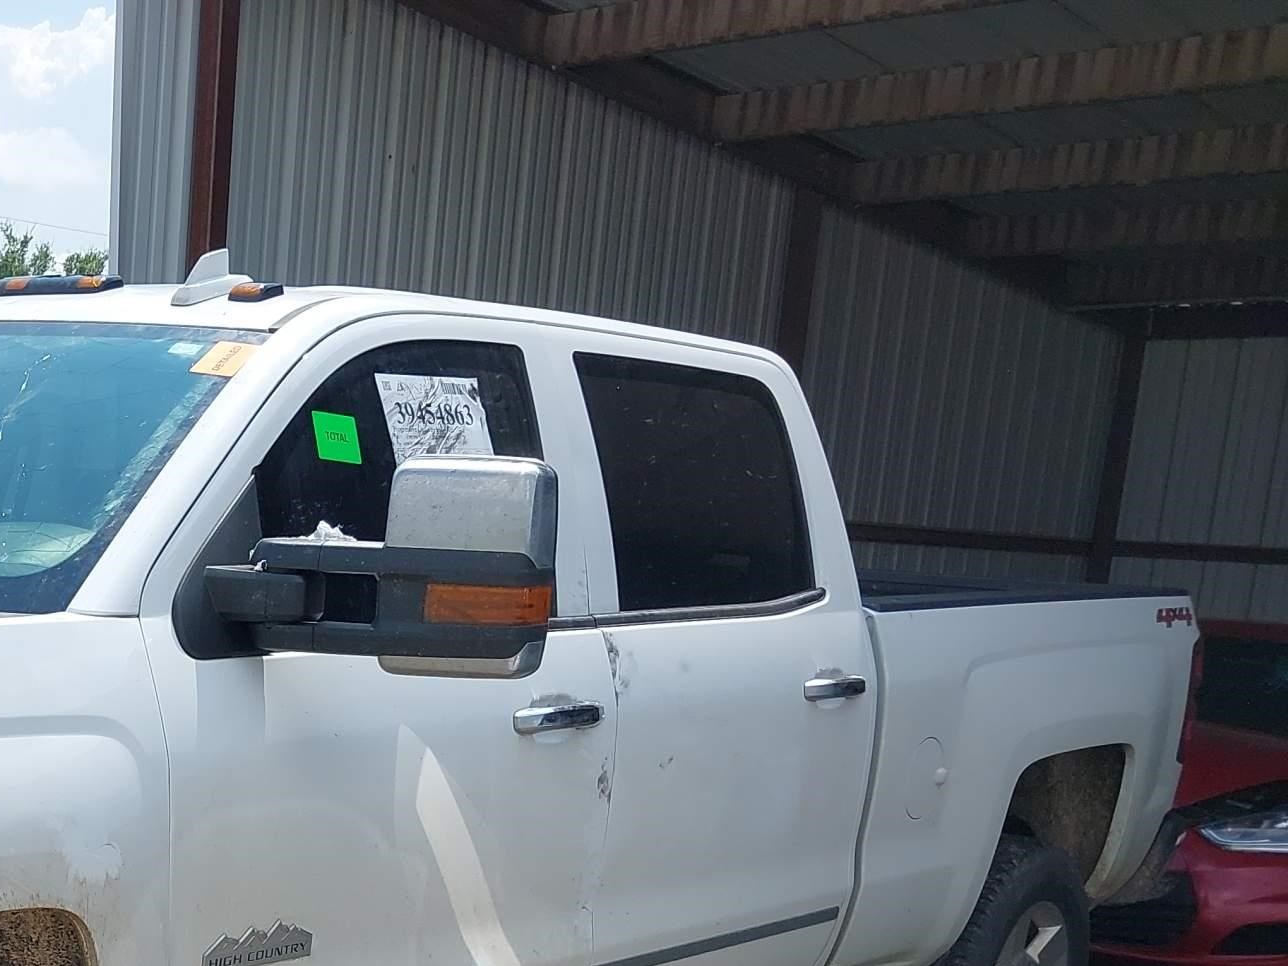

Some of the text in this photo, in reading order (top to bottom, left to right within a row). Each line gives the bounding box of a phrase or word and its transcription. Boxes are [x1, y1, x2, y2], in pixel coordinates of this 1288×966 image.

[211, 345, 242, 372] DETAILED
[394, 401, 474, 426] 39454863
[325, 431, 349, 443] TOTAL
[247, 942, 307, 962] COUNTRY
